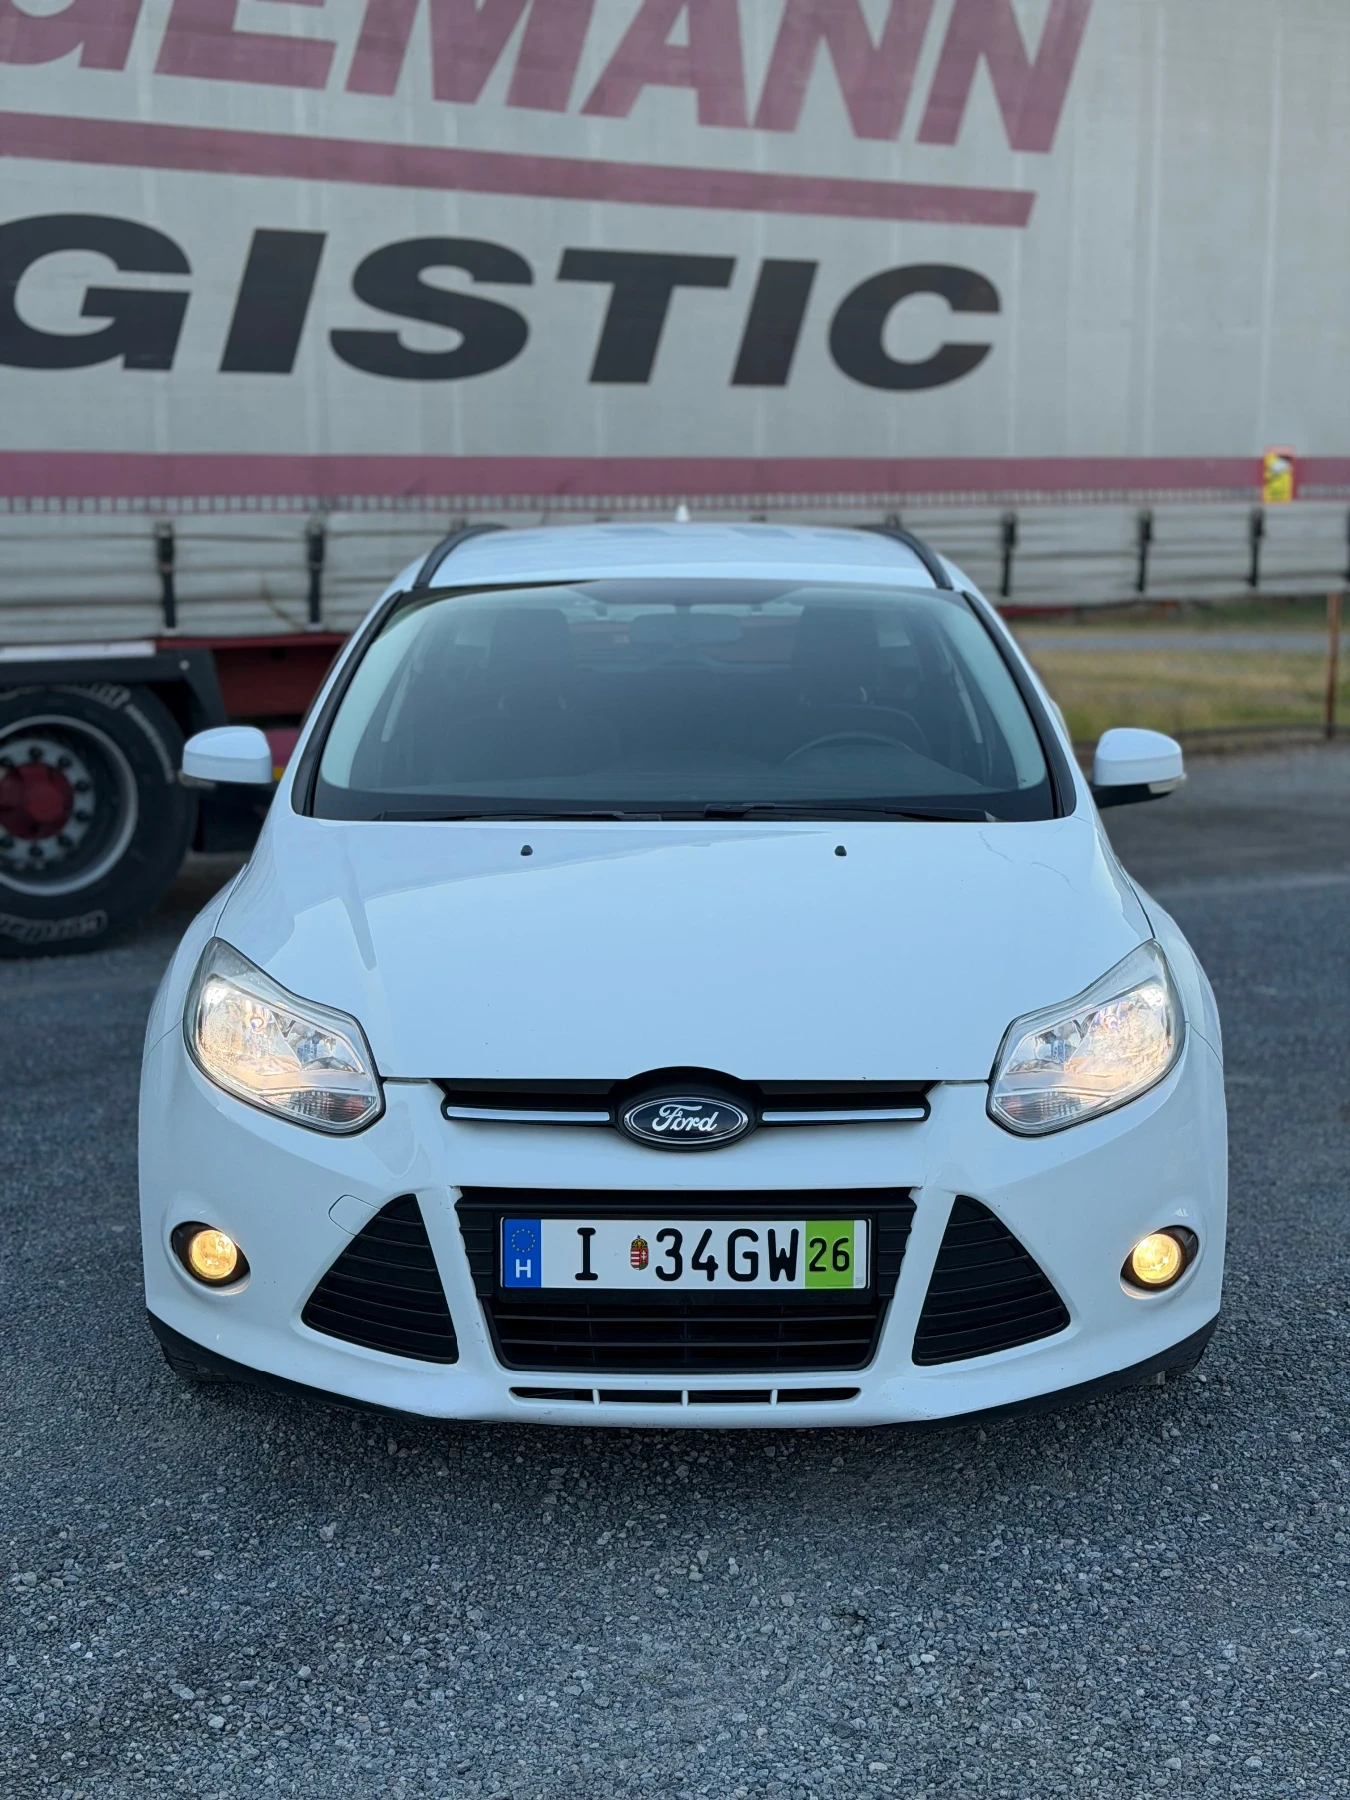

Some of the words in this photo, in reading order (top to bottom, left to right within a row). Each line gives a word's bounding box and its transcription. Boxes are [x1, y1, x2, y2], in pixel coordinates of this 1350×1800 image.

[0, 212, 1002, 393] GISTIC
[652, 1104, 719, 1131] Ford
[515, 1259, 532, 1279] H
[575, 1227, 599, 1281] I
[655, 1228, 799, 1282] 34GW
[808, 1237, 850, 1272] 26
